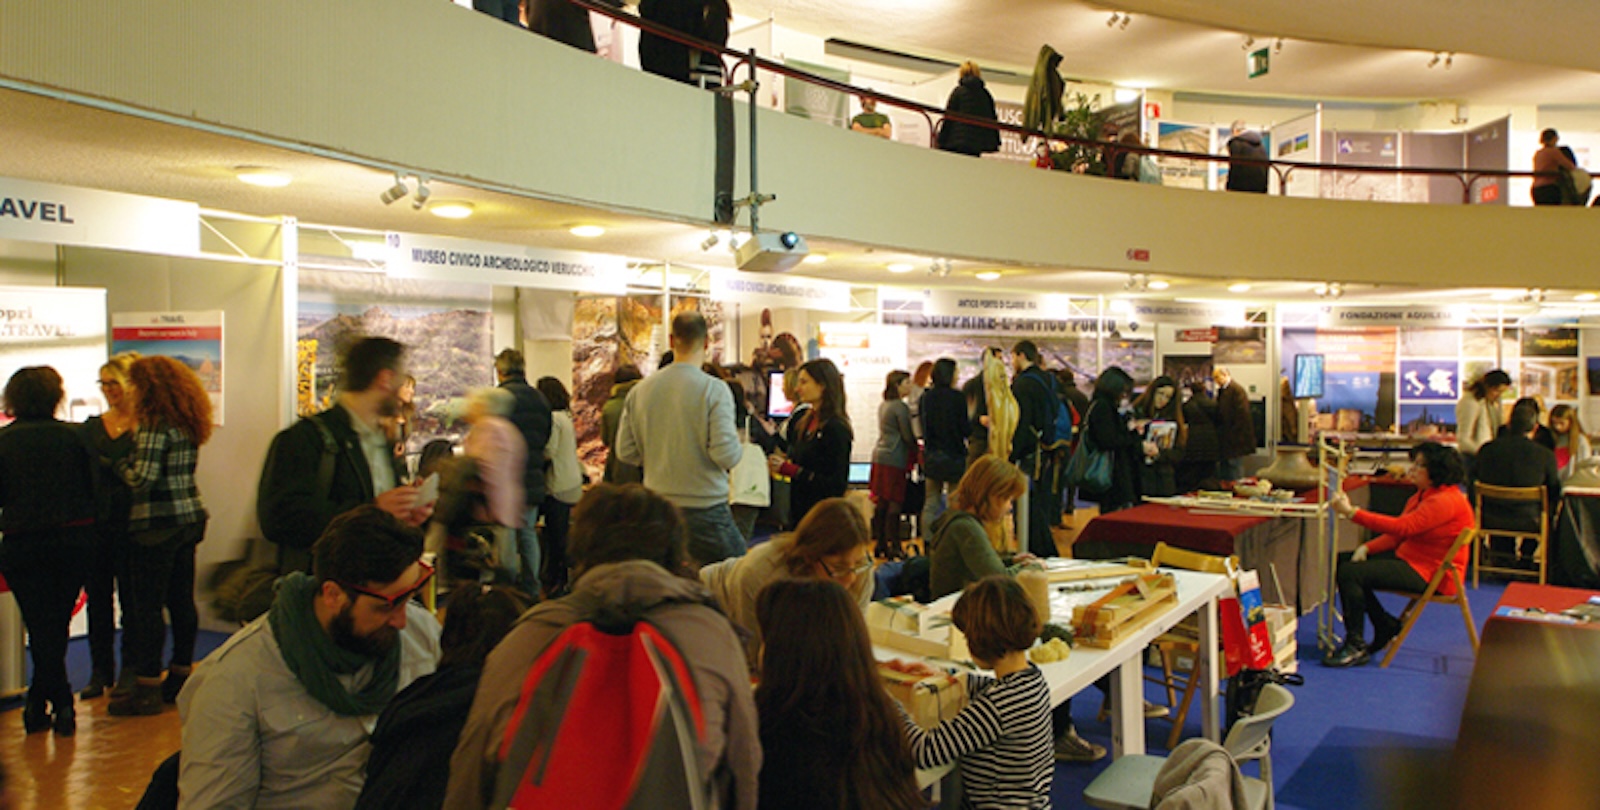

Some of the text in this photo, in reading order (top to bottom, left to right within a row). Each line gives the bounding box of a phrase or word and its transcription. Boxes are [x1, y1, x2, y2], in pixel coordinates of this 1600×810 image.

[412, 247, 447, 265] MUSEO
[449, 251, 481, 268] CIVICO
[483, 254, 549, 273] ARCHEOLOGICO
[1340, 311, 1402, 320] FONDAZIONE
